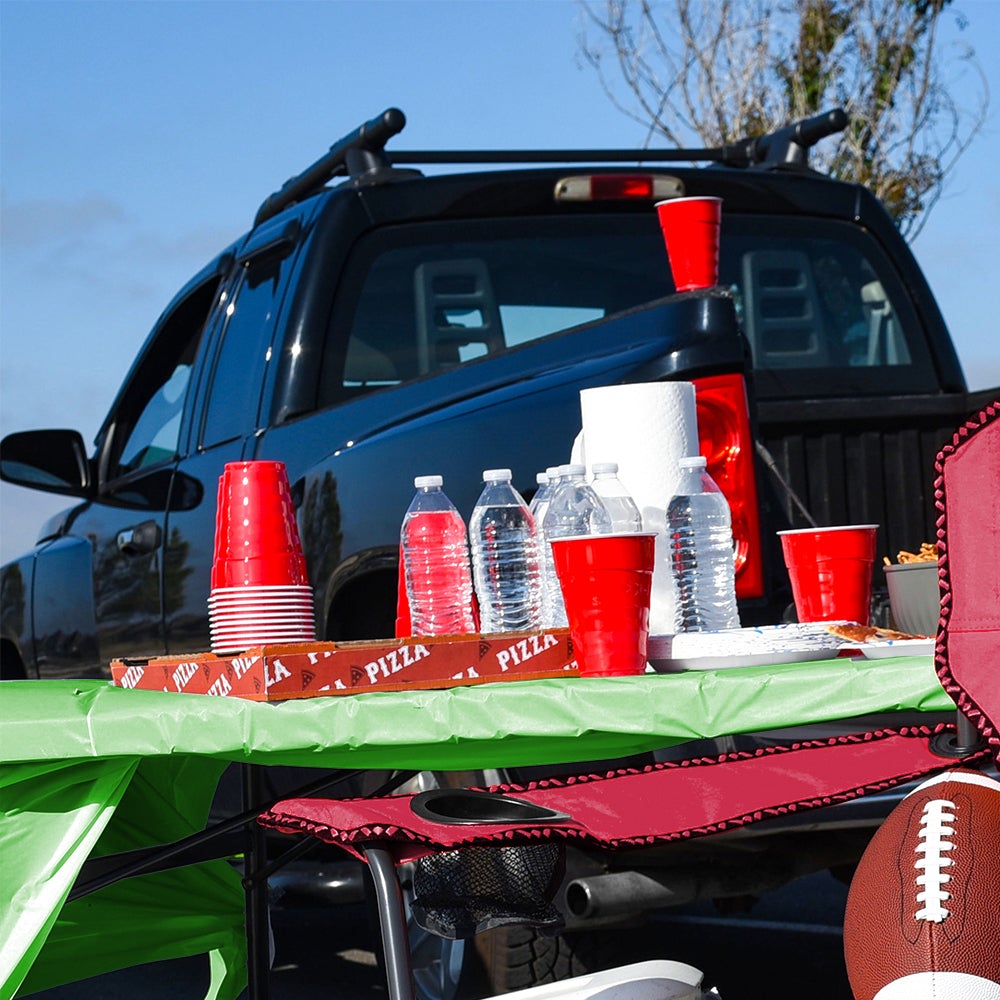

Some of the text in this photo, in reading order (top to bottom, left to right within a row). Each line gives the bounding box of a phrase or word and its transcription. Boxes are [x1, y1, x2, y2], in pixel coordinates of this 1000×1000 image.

[364, 644, 431, 684] PIZZA
[495, 634, 559, 672] PIZZA
[120, 666, 145, 689] PIZZA
[172, 662, 200, 693] PIZZA
